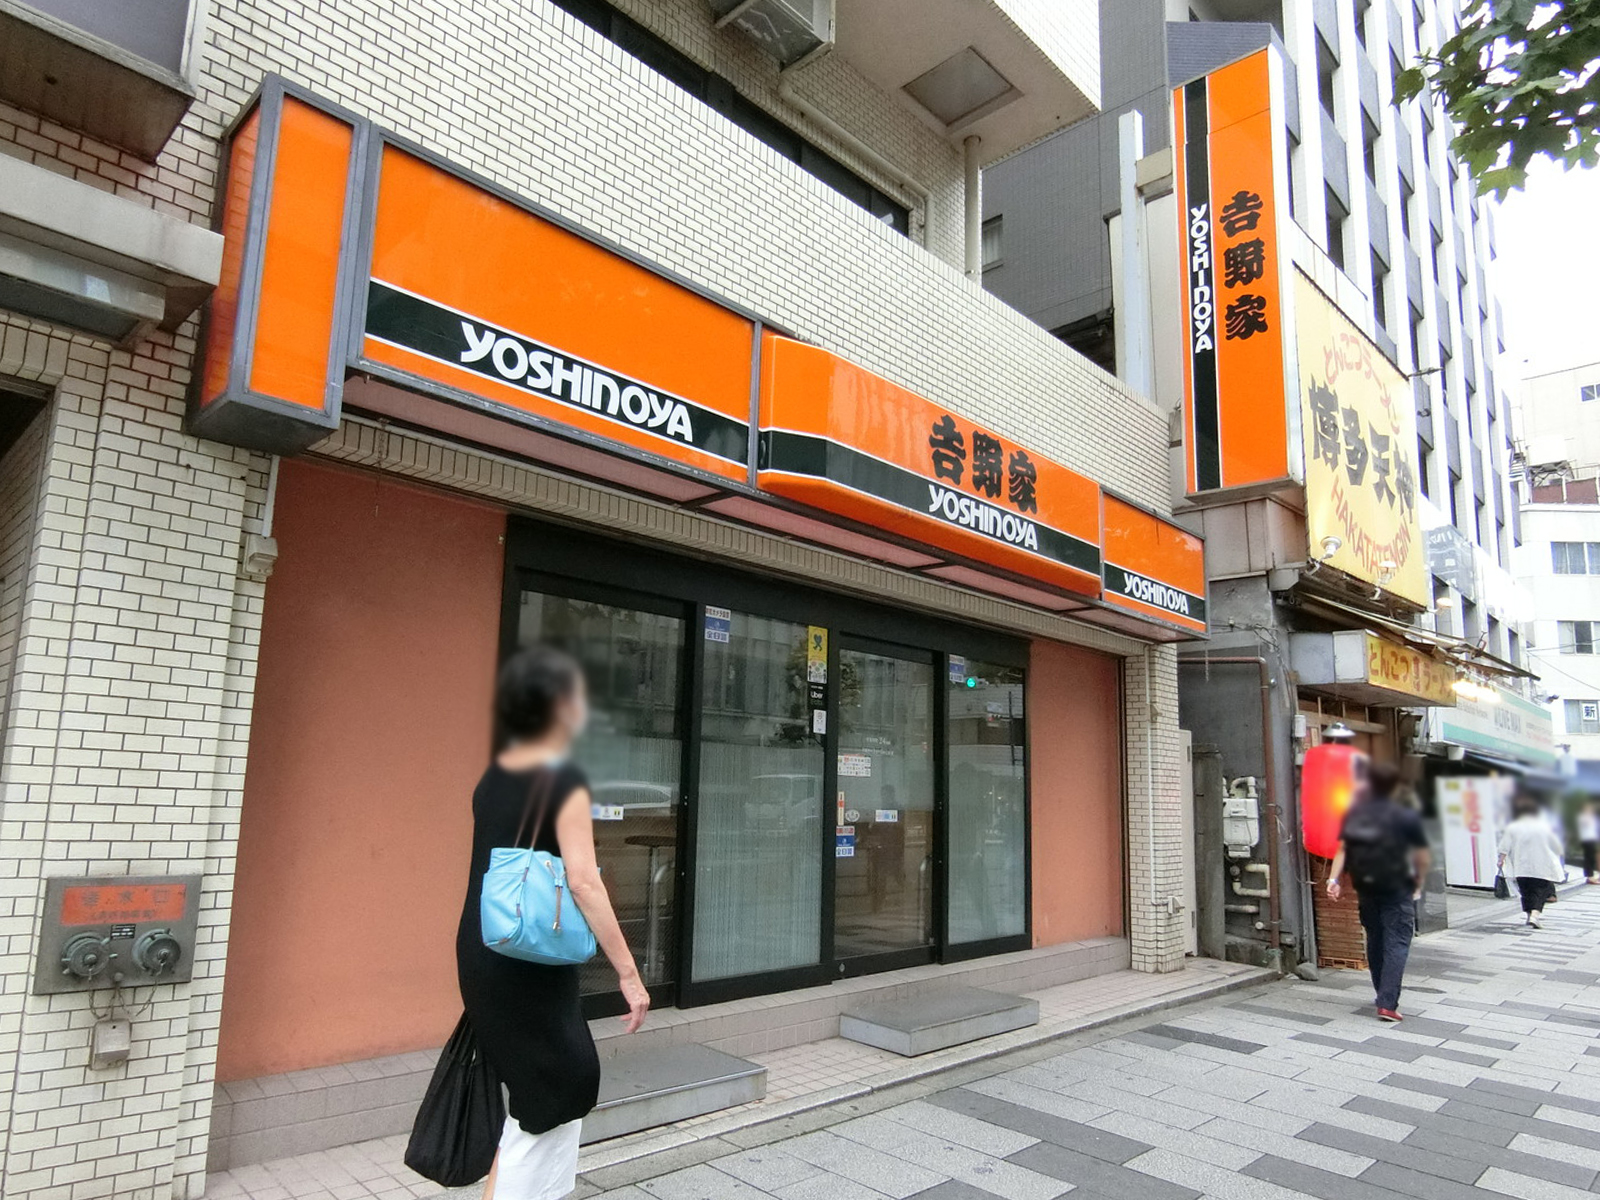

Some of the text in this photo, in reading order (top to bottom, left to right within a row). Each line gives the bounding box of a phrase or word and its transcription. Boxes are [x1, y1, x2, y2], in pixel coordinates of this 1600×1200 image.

[1190, 203, 1213, 354] YOSHINOYA
[1219, 190, 1268, 341] 吉野家
[460, 321, 693, 443] YOSHINOYA
[929, 415, 1038, 514] 吉野家
[1308, 373, 1414, 524] 博多天神
[928, 484, 1038, 550] YOSHINOYA
[1124, 572, 1189, 615] YOSHINOYA
[810, 691, 823, 699] Uber
[1369, 643, 1409, 682] とんこつ
